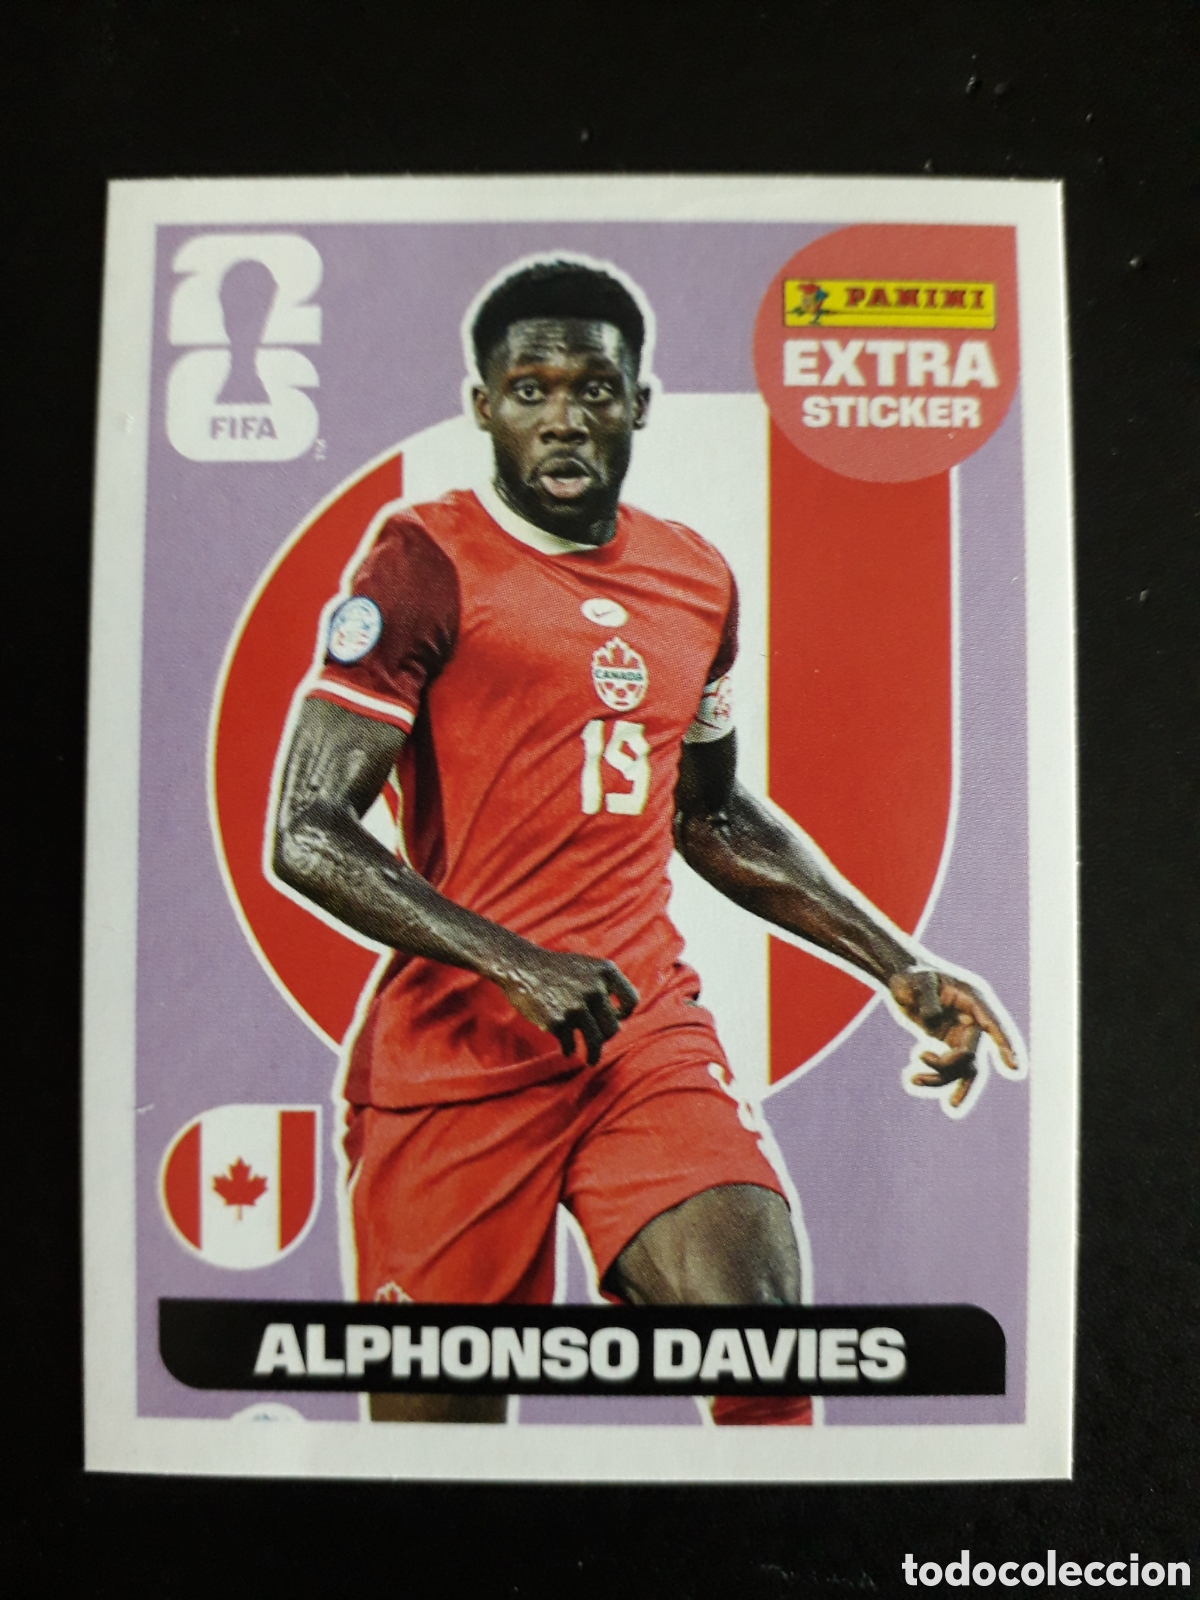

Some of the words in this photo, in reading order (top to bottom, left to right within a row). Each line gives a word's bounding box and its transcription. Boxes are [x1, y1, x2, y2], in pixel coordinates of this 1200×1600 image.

[846, 287, 985, 309] PANINI
[783, 338, 998, 389] EXTRA
[210, 416, 278, 440] FIFA
[802, 395, 981, 428] STICKER
[594, 669, 643, 681] CANADA
[581, 719, 651, 816] 19
[254, 1323, 640, 1380] ALPHONSO
[653, 1326, 907, 1383] DAVIES
